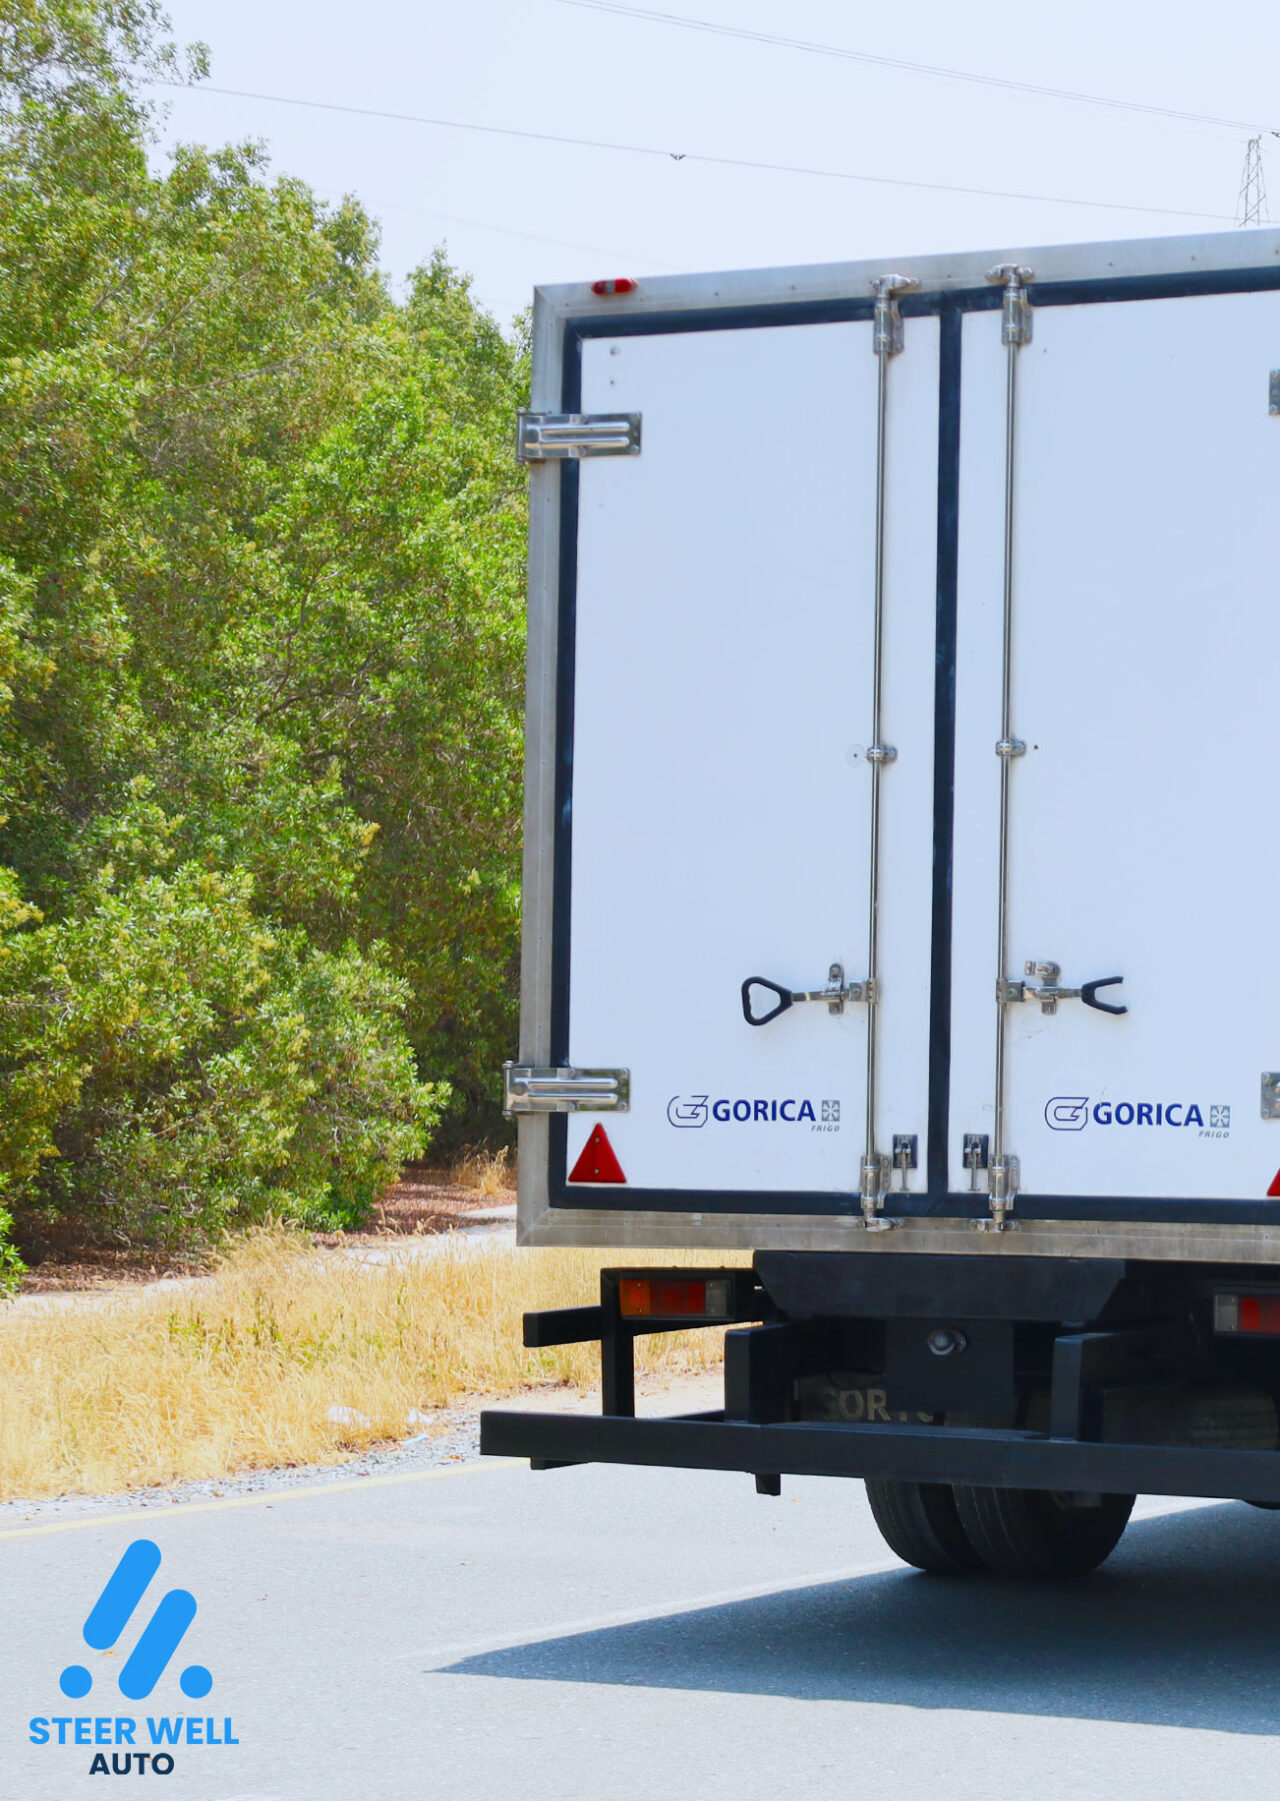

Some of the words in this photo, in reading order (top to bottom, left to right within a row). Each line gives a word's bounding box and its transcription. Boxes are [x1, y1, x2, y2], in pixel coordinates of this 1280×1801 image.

[712, 1099, 816, 1122] GORICA
[1093, 1101, 1204, 1127] GORICA
[811, 1124, 840, 1133] FRIGO
[1198, 1129, 1230, 1139] FRIGO
